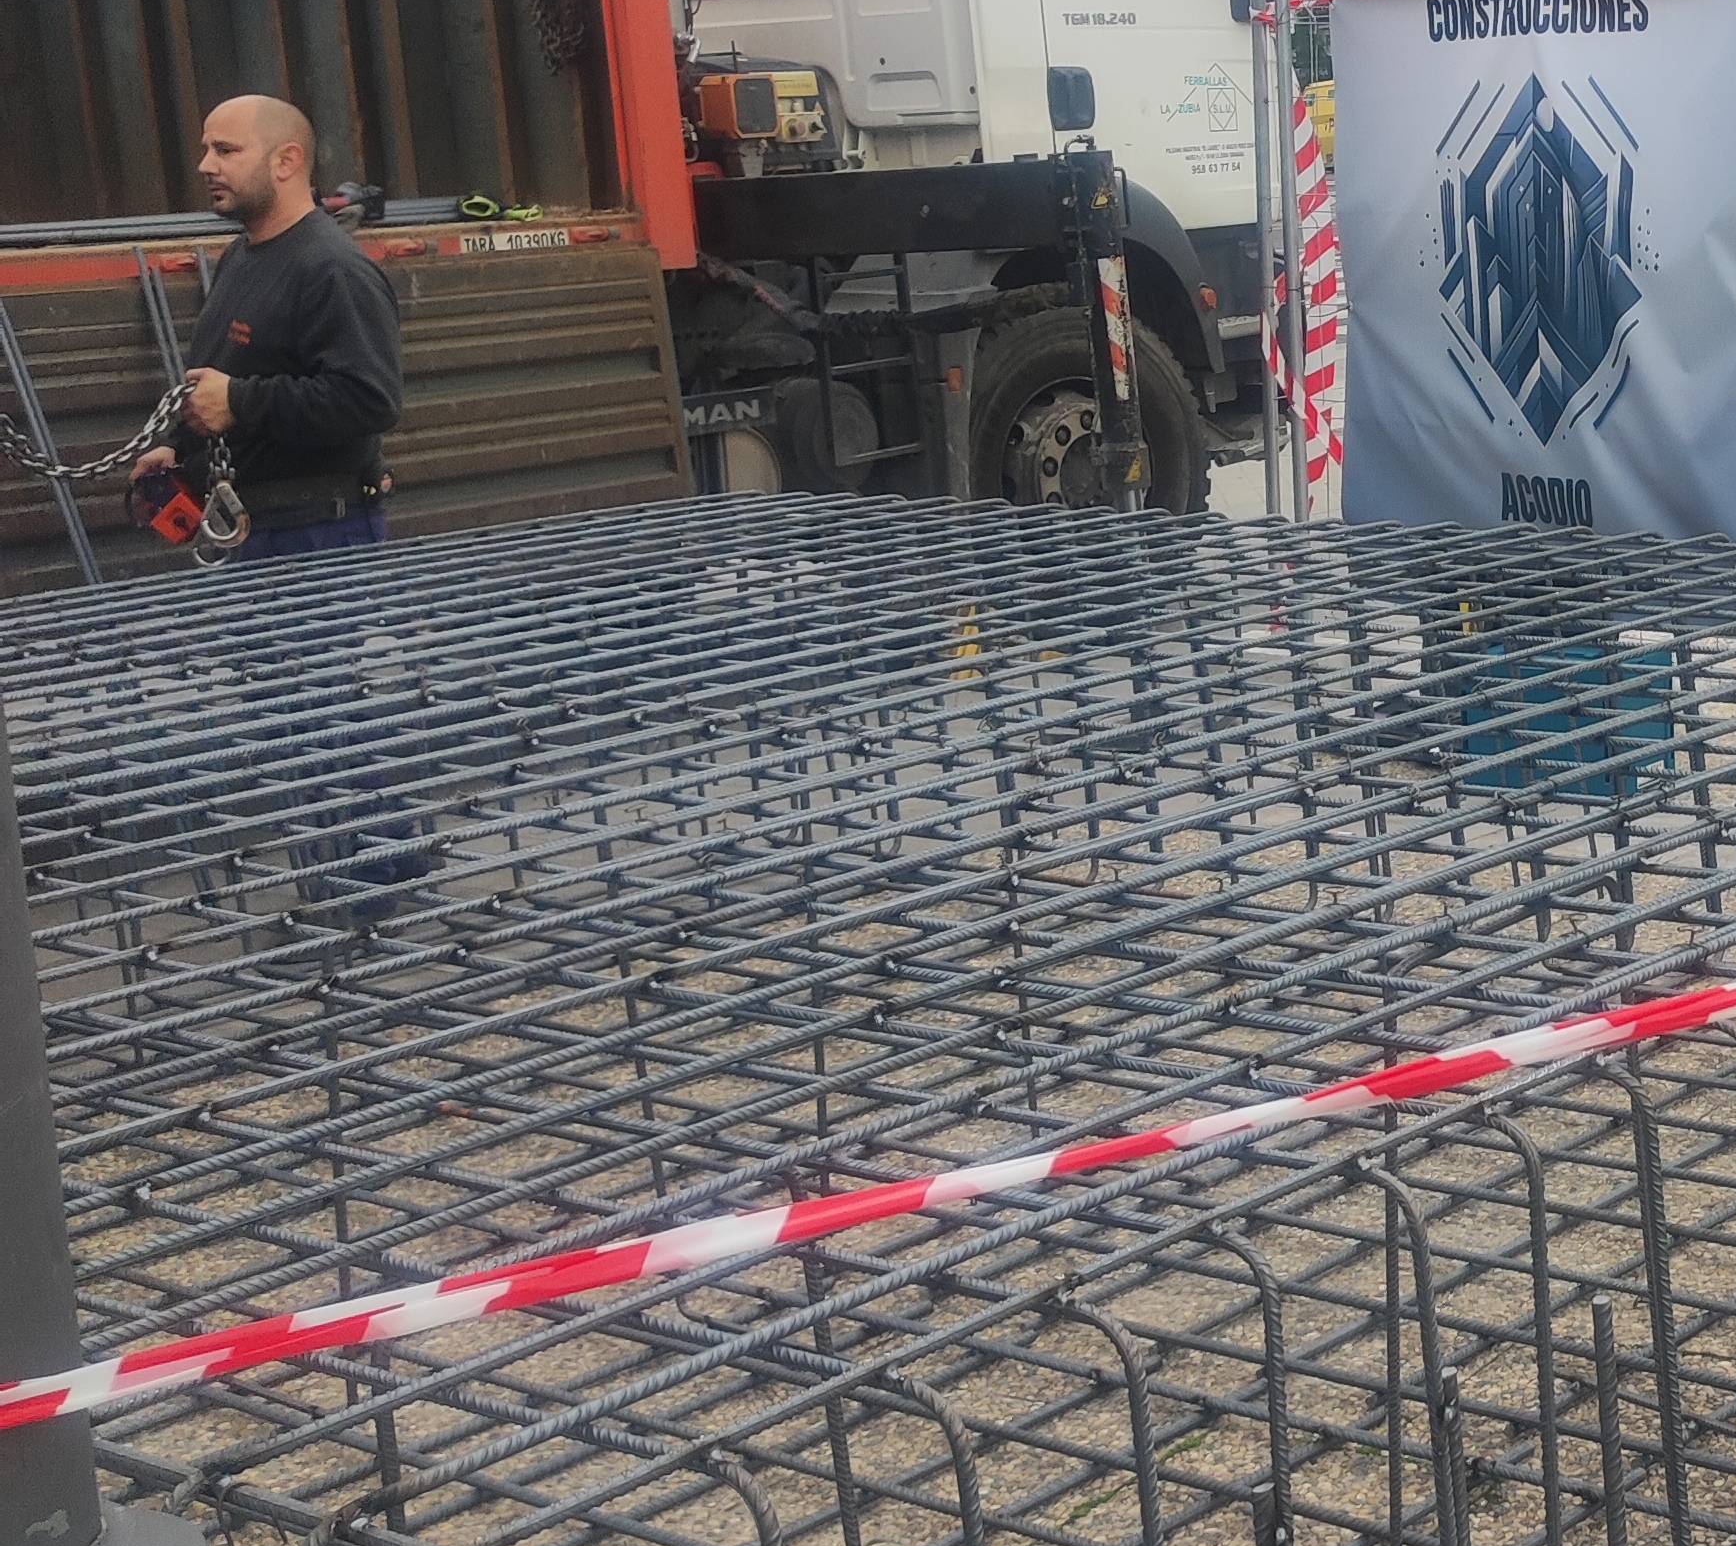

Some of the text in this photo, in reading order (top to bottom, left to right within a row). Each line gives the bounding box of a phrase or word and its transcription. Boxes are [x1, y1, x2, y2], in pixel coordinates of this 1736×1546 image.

[1184, 75, 1228, 87] FERRALLAS
[1160, 103, 1201, 115] LA ZUBIA
[1220, 162, 1230, 172] 77
[464, 235, 496, 253] TARA
[683, 399, 761, 426] MAN
[1501, 472, 1593, 528] ACODIO
